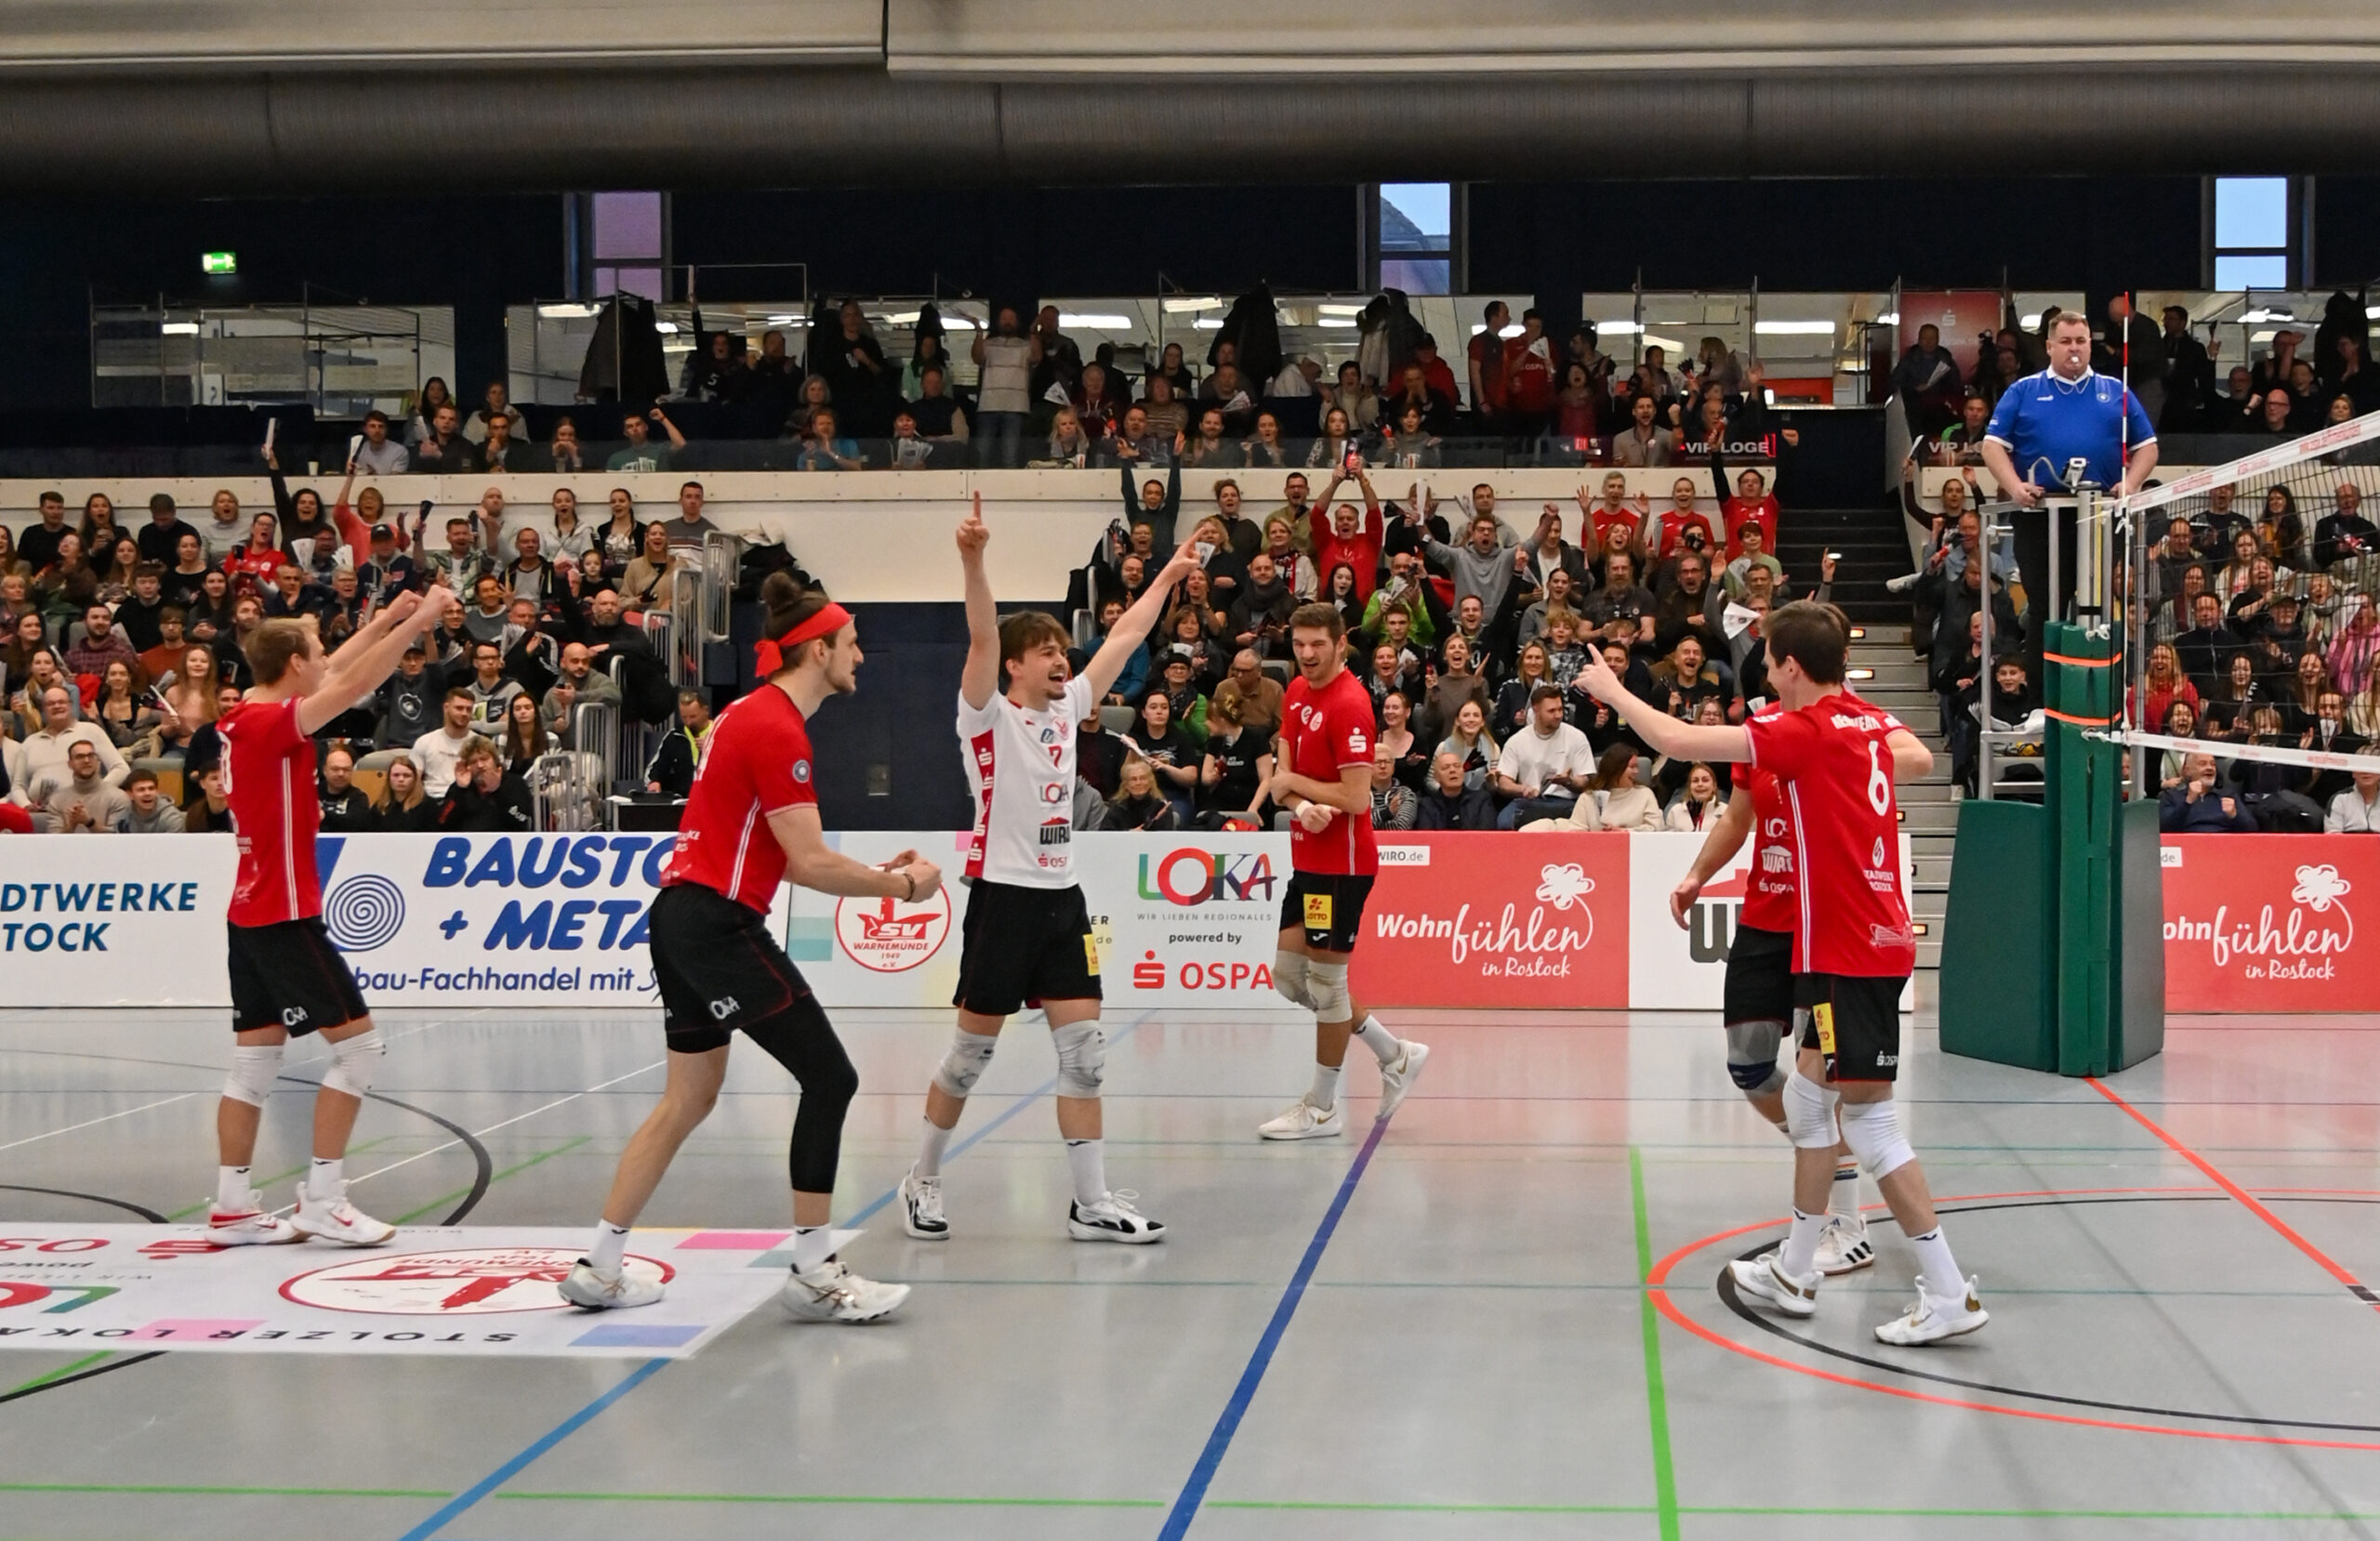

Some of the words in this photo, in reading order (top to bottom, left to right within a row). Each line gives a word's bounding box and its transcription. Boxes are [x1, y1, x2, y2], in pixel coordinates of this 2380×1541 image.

[1721, 441, 1768, 454] LOGE
[1928, 441, 1958, 454] VIP
[1049, 744, 1063, 769] 7
[1867, 740, 1890, 817] 6
[1137, 847, 1278, 907] LOKA
[0, 883, 198, 913] DTWERKE
[1137, 913, 1157, 921] WIR
[1162, 913, 1198, 921] LIEBEN
[1204, 913, 1273, 921] REGIONALES
[3, 922, 112, 953] TOCK
[853, 940, 929, 951] WARNEMÜNDE
[1169, 932, 1223, 946] powered
[1227, 932, 1242, 946] by
[880, 952, 901, 960] 1949
[1482, 959, 1502, 977] in
[1504, 955, 1571, 978] Rostock
[589, 967, 635, 991] mit
[1180, 962, 1275, 991] OSPA
[2245, 964, 2266, 980] in
[2268, 957, 2335, 981] Rostock
[208, 1329, 519, 1343] STOLZER
